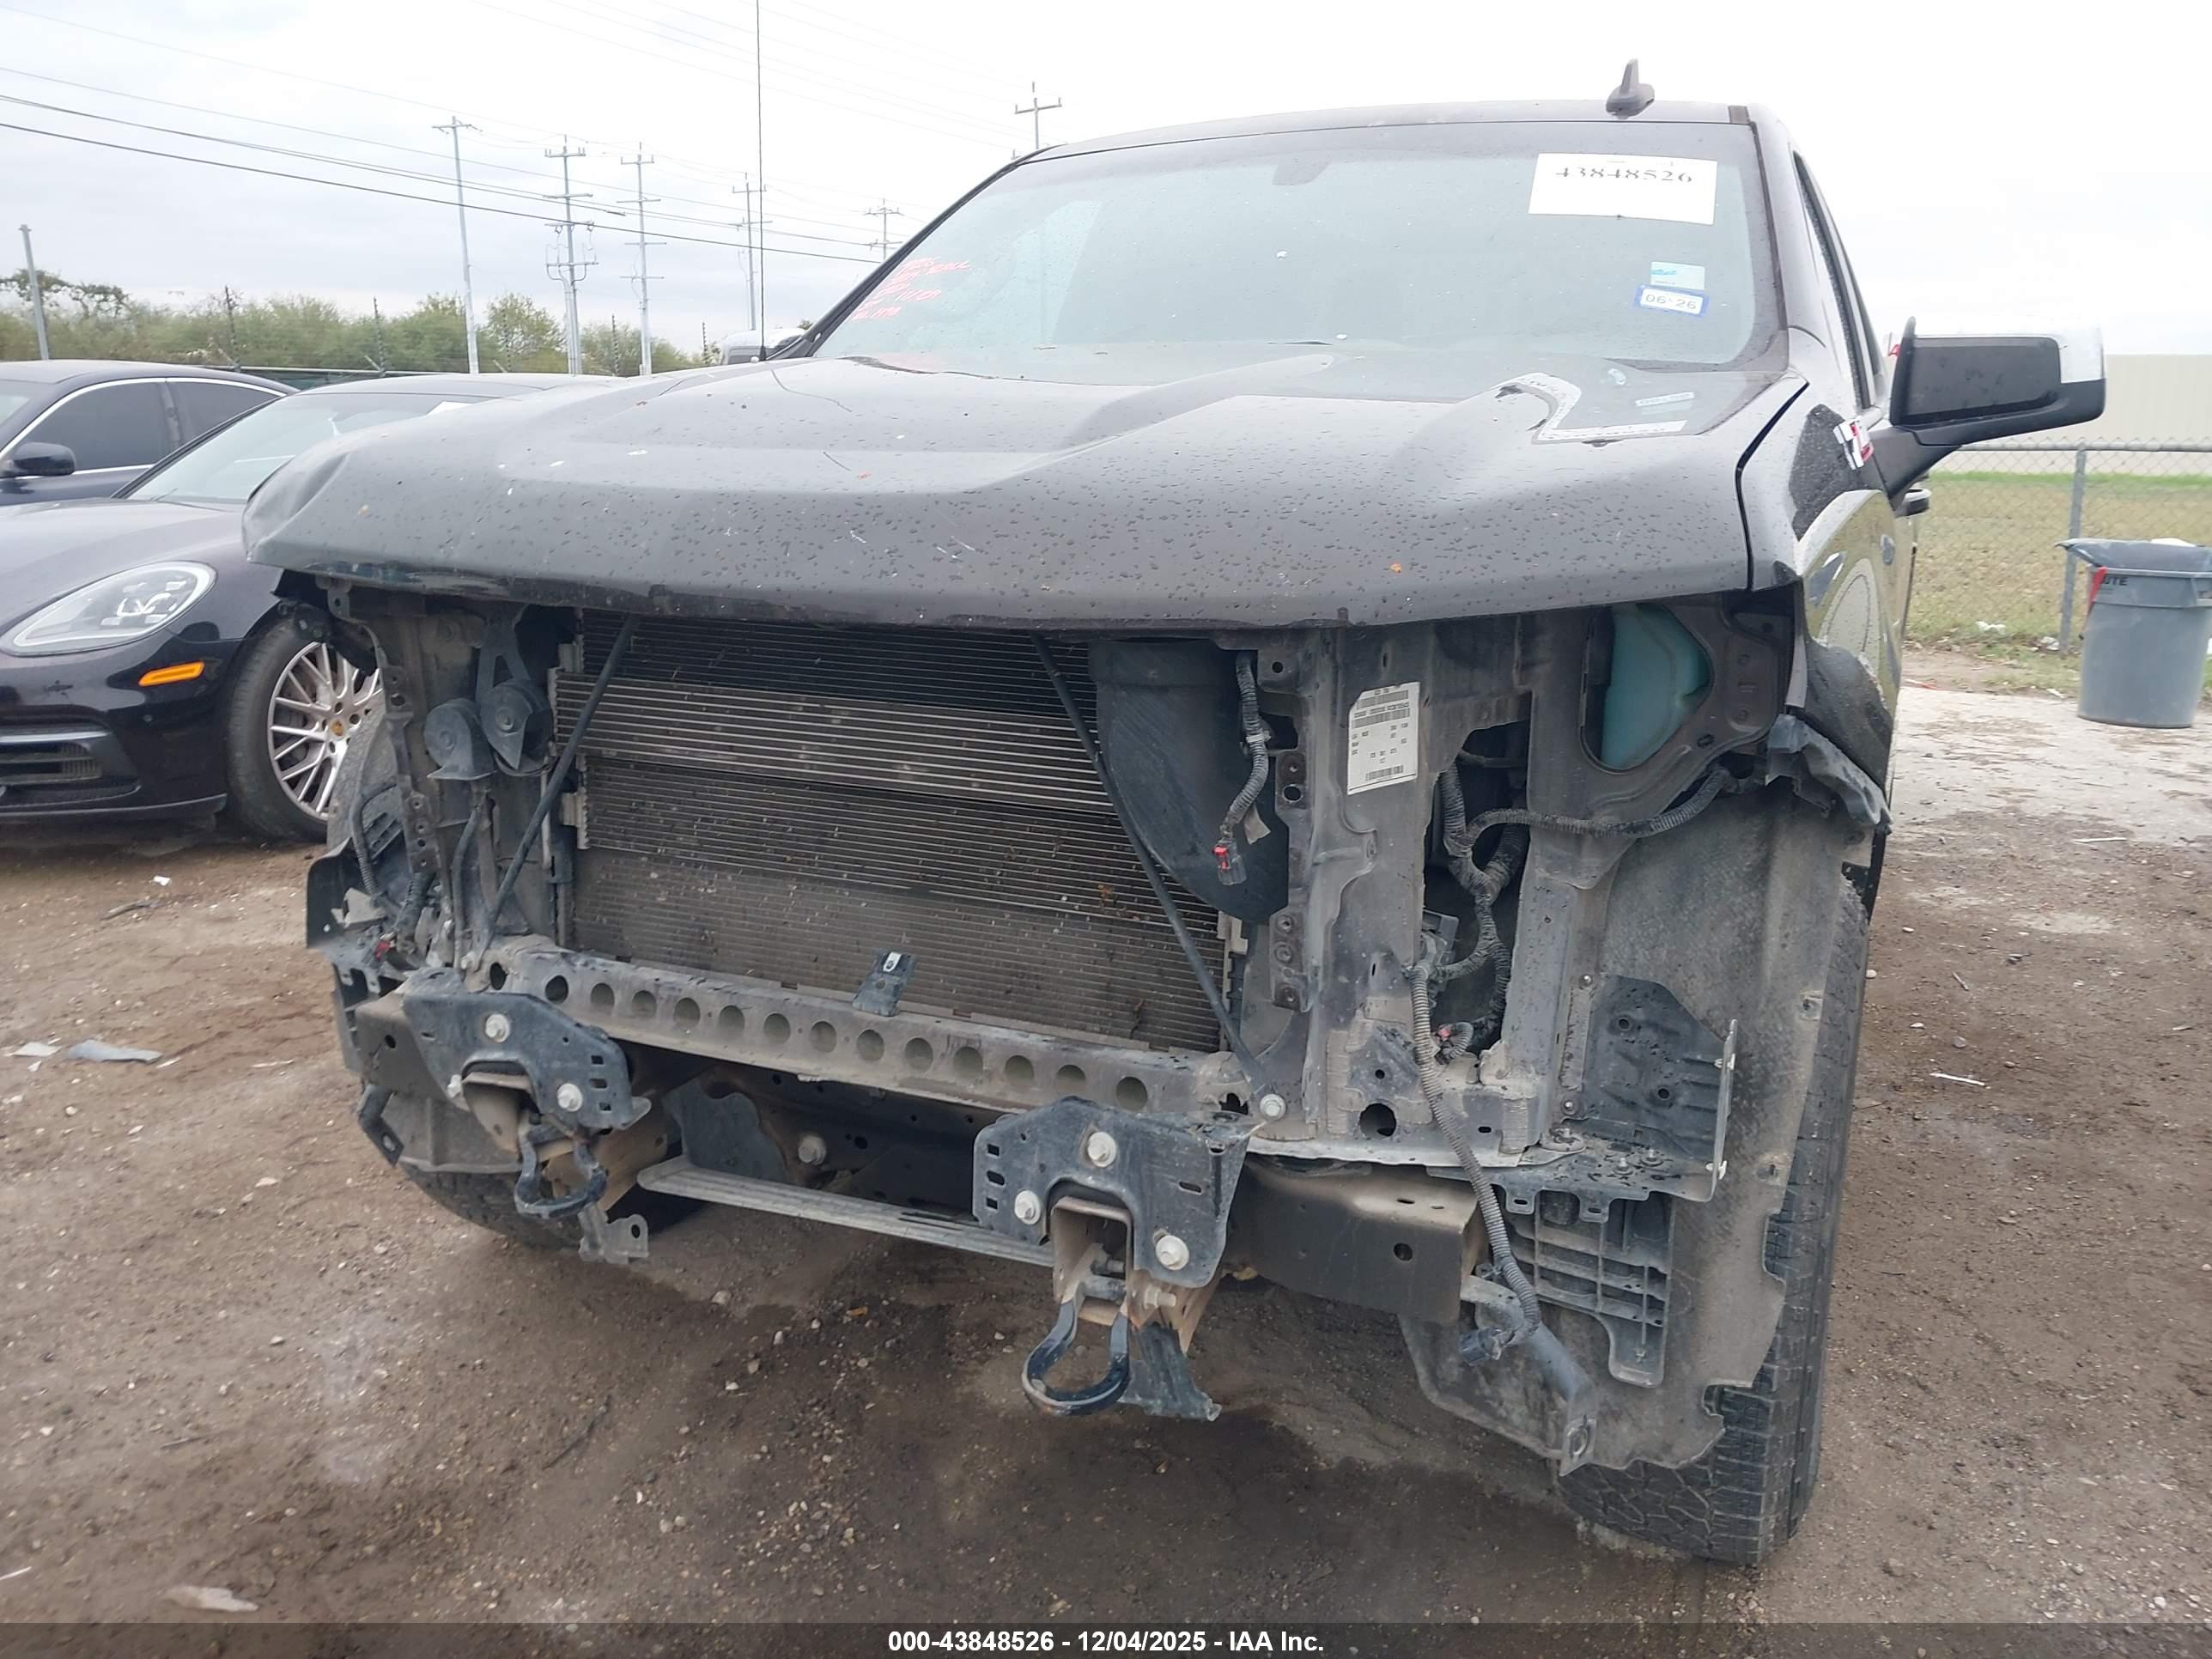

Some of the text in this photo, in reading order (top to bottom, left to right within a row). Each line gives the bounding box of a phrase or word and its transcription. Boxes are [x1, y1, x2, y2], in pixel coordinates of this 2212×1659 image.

[1555, 167, 1692, 183] 43848526
[1645, 294, 1697, 310] 06 26
